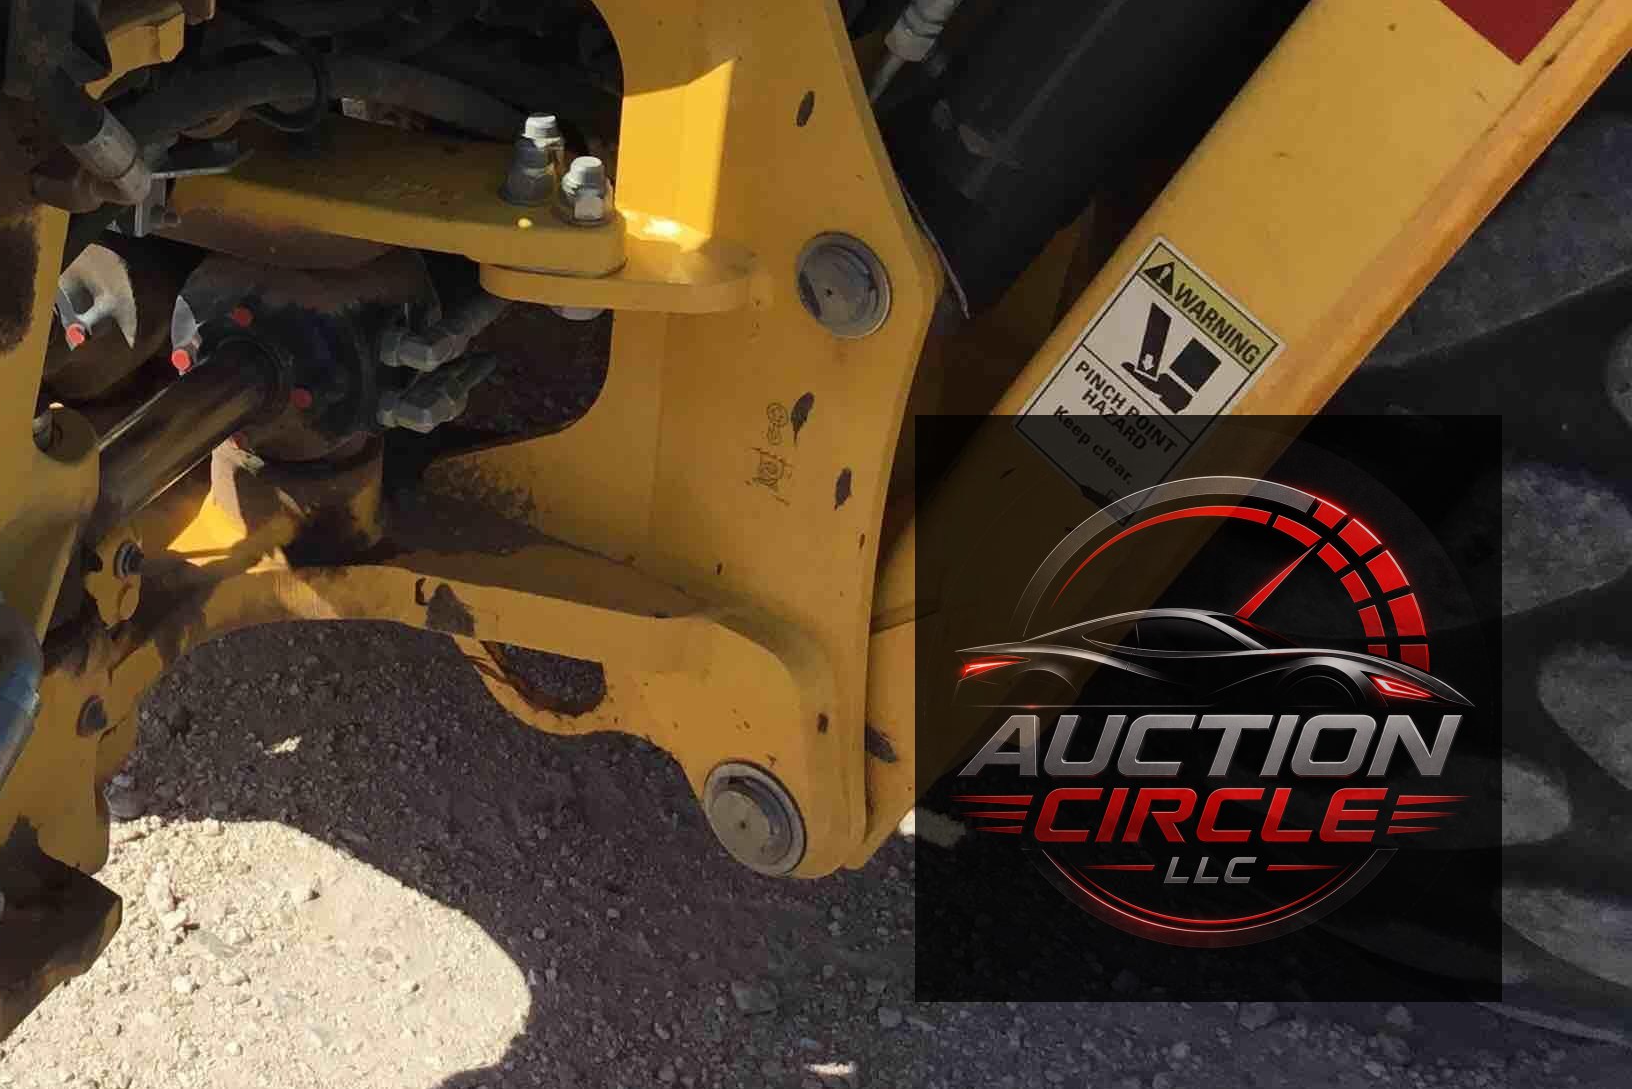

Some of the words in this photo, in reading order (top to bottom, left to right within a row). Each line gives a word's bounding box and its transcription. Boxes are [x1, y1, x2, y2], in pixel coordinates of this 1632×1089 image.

[1174, 282, 1261, 366] WARNING
[1052, 404, 1091, 447] Keep
[1090, 440, 1134, 485] clear.
[1074, 360, 1127, 410] PINCH
[1124, 405, 1178, 454] POINT
[1080, 387, 1149, 452] HAZARD
